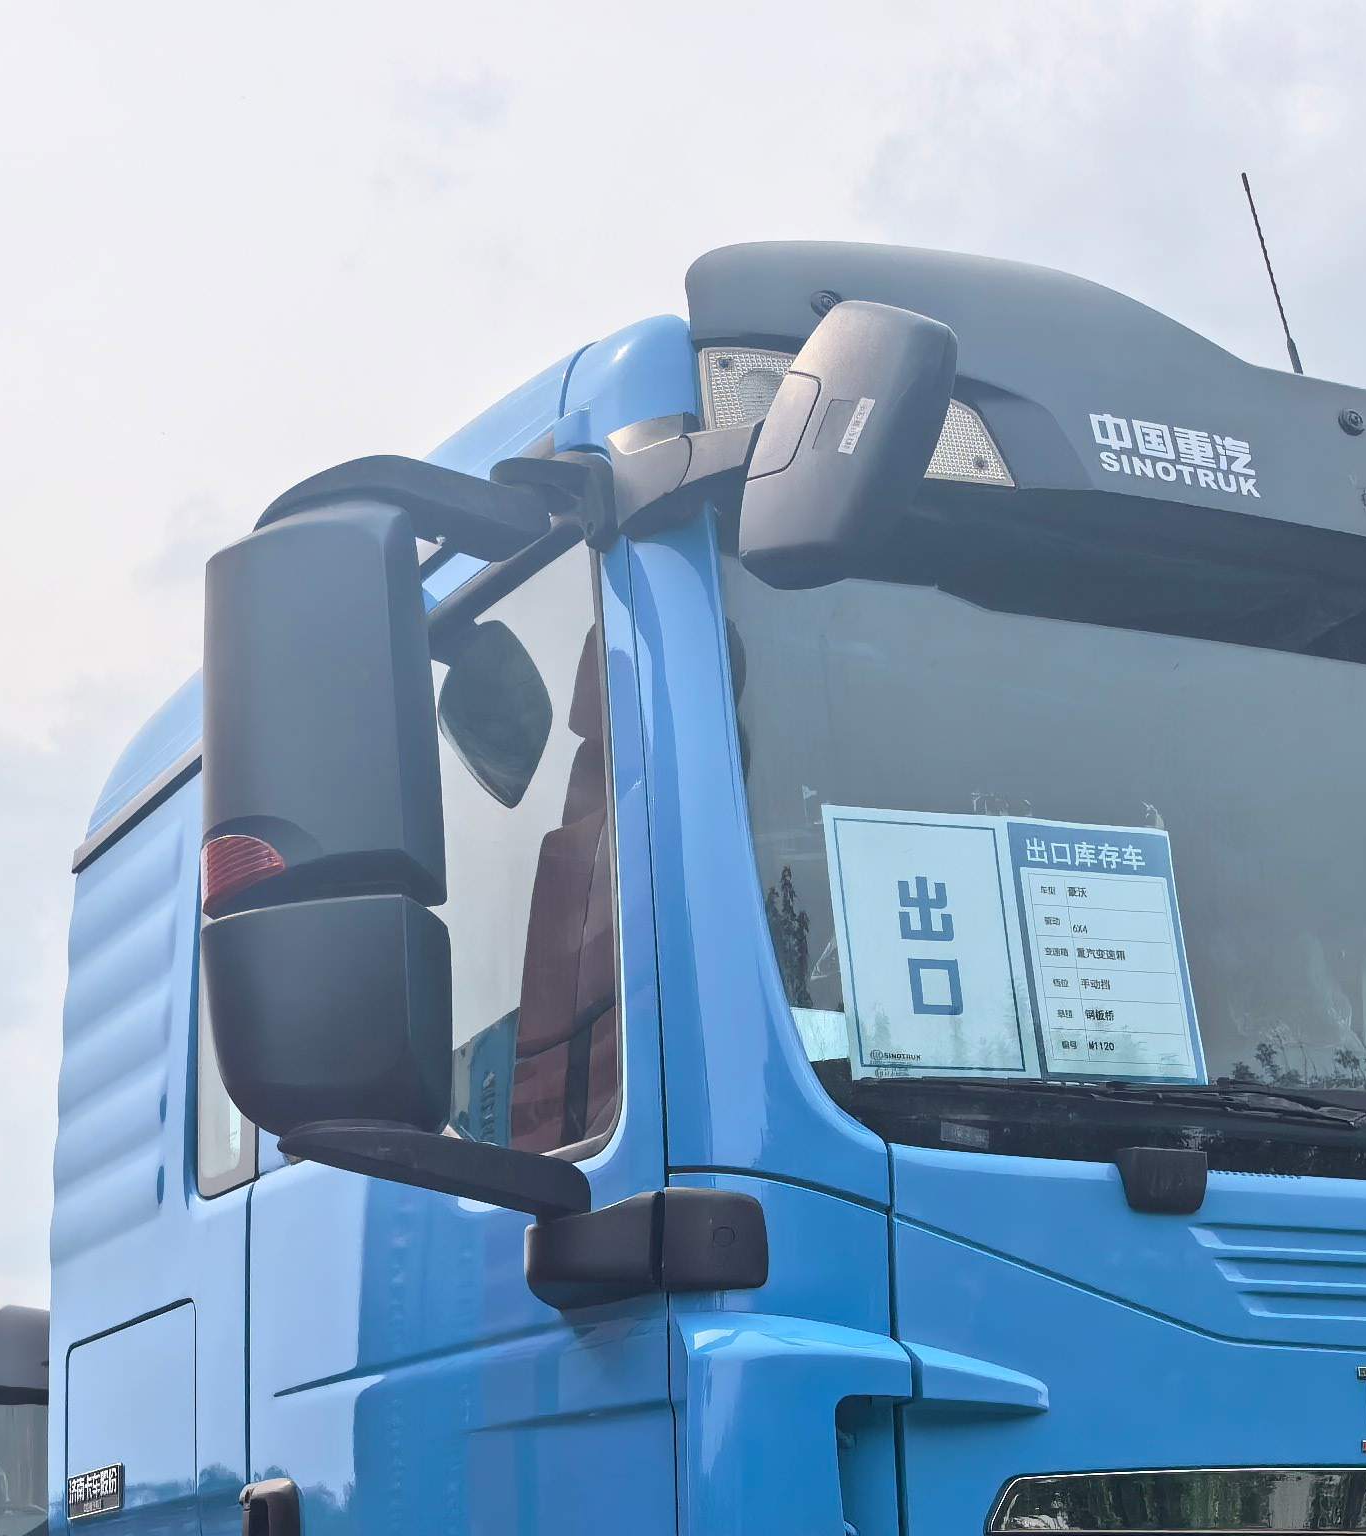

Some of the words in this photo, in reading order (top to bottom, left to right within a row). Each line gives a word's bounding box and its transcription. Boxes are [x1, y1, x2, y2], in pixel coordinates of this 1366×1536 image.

[1088, 413, 1256, 476] 中国重汽
[1099, 451, 1262, 498] SINOTRUK
[1025, 837, 1146, 870] 出口库存车
[897, 875, 964, 1015] 出口
